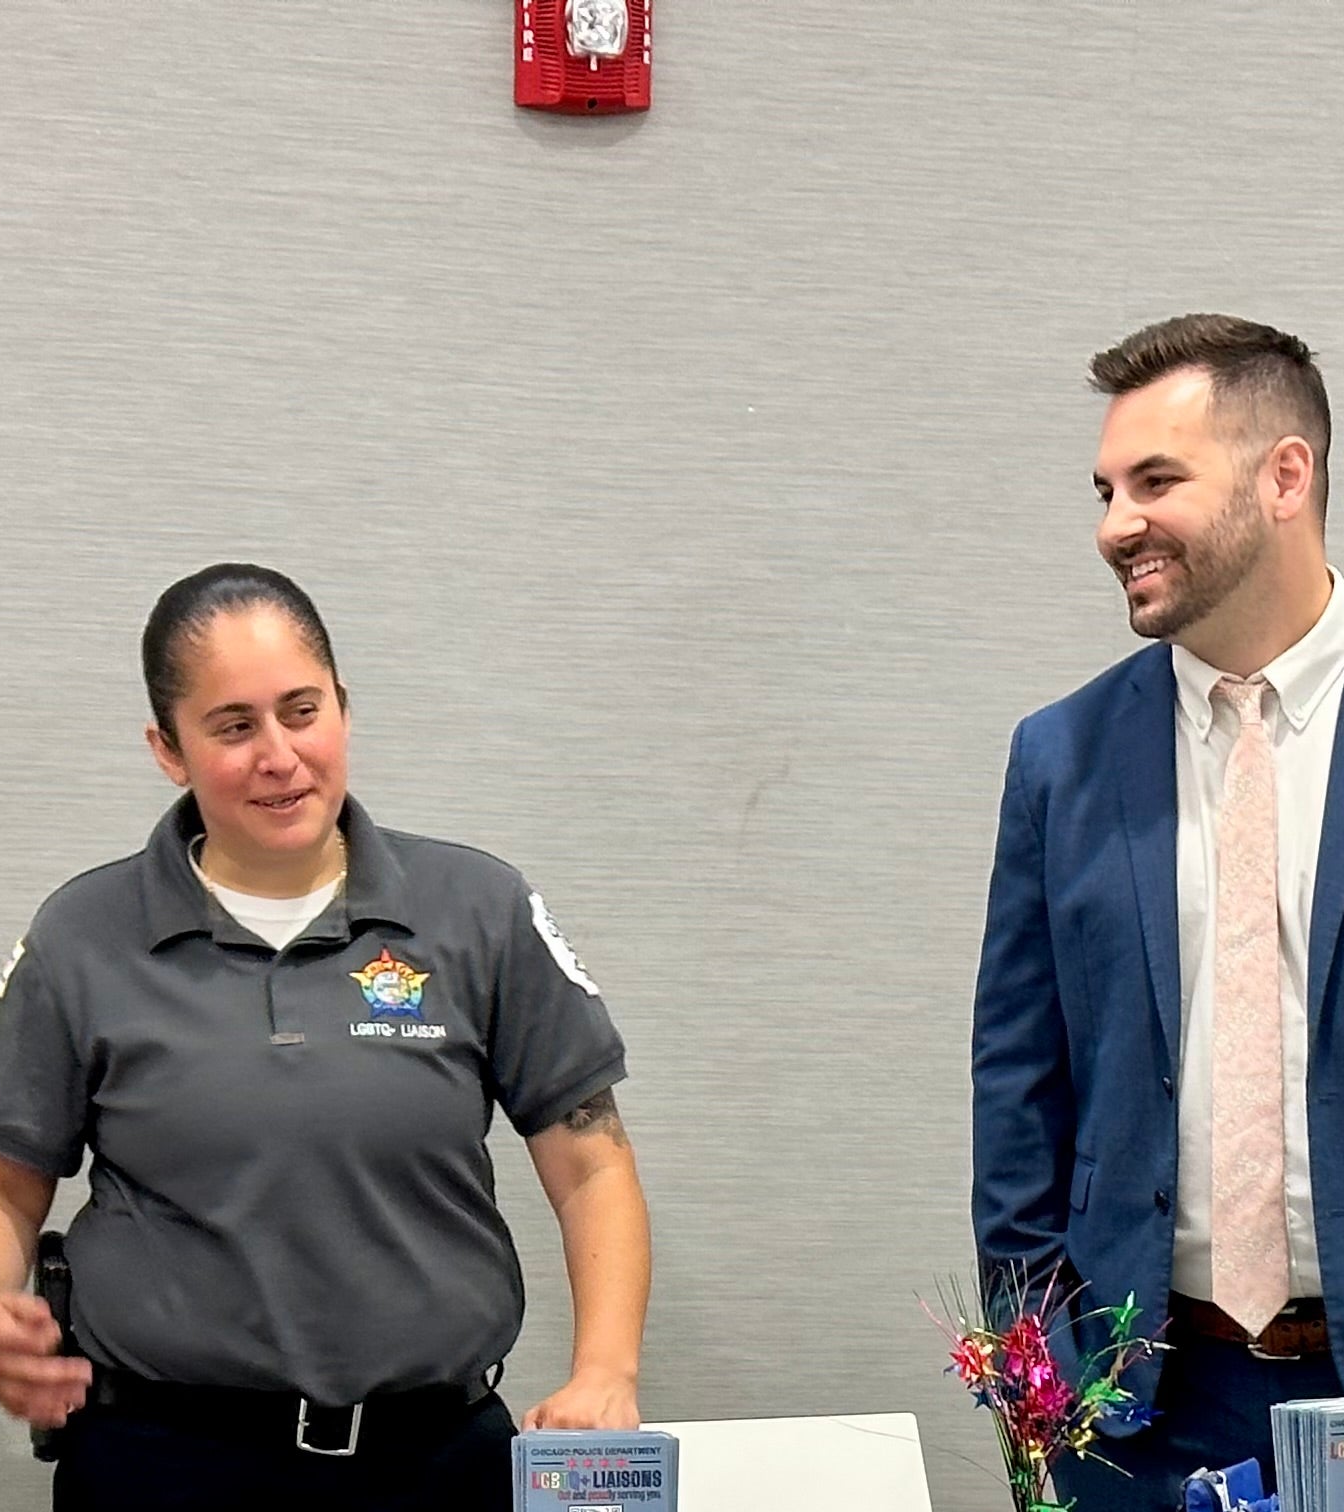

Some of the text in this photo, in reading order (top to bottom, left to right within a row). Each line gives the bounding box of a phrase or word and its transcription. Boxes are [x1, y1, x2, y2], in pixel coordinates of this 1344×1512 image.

[573, 1447, 603, 1456] POLICE
[605, 1446, 661, 1456] DEPARTMENT
[593, 1469, 662, 1488] LIAISONS
